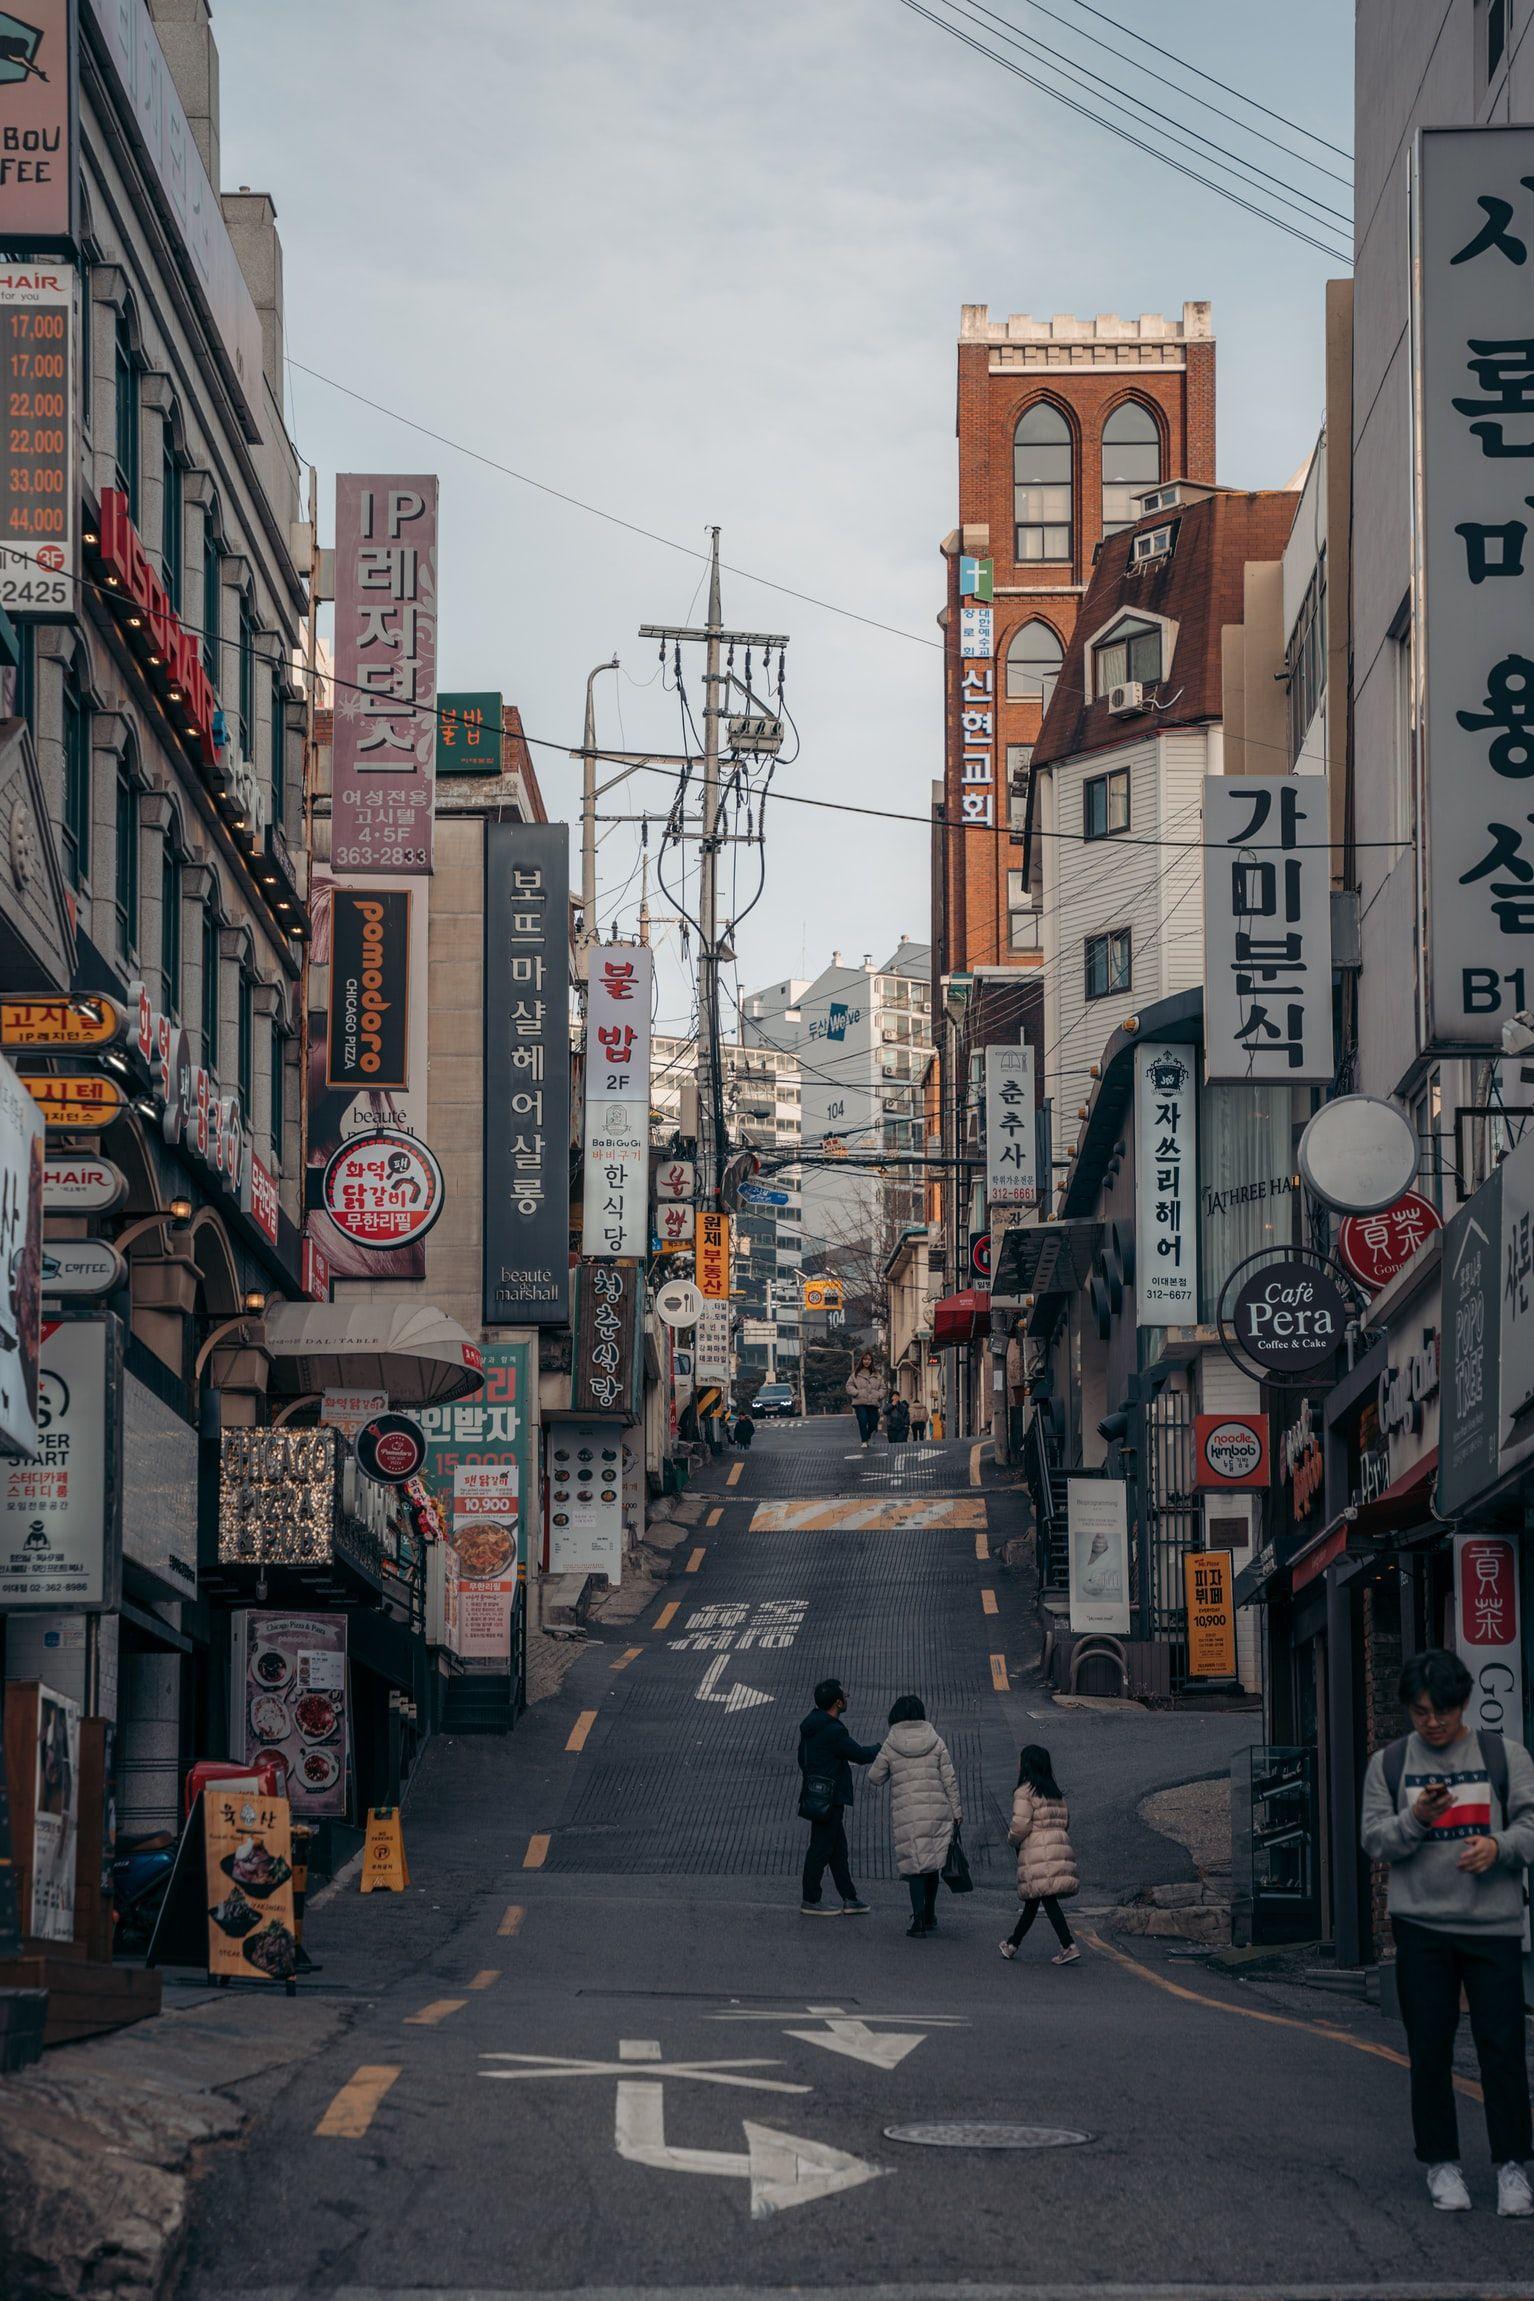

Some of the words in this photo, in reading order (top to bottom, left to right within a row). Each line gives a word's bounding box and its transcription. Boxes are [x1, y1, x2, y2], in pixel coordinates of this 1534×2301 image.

[10, 315, 64, 340] 17,000
[10, 354, 64, 379] 17,000
[10, 393, 64, 419] 22,000
[10, 430, 64, 456] 22,000
[10, 468, 64, 495] 33,000
[10, 507, 64, 533] 44,000
[354, 547, 419, 774] 레지던스
[962, 670, 993, 827] 신현교회
[342, 789, 428, 807] 여성전용
[354, 808, 416, 825] 고시텔
[1227, 786, 1307, 1068] 가미분식
[352, 900, 392, 1074] pomodoro
[345, 977, 357, 1033] CHICAGO
[344, 1035, 356, 1070] PIZZA
[606, 1075, 630, 1090] 2F
[827, 1100, 845, 1121] 104
[999, 1079, 1026, 1170] 춘추사
[346, 1160, 386, 1182] 화덕
[342, 1183, 407, 1210] 닭갈비
[1155, 1102, 1182, 1267] 자쓰리헤어
[604, 1164, 628, 1251] 한식당
[345, 1212, 412, 1232] 무한리필
[703, 1216, 722, 1247] 원제
[703, 1250, 723, 1295] 부동산
[496, 1282, 559, 1302] marshall
[1146, 1290, 1192, 1300] 312-6677
[1246, 1303, 1336, 1337] Pera
[1258, 1339, 1289, 1350] Coffee
[1292, 1339, 1300, 1349] &
[1302, 1338, 1327, 1349] Cake
[1211, 1444, 1256, 1459] kimbob
[1214, 1433, 1256, 1446] noodle
[464, 1498, 510, 1512] 10,900
[1195, 1569, 1222, 1587] 피자
[1195, 1587, 1223, 1604] 뷔페
[1193, 1615, 1226, 1628] 10,900
